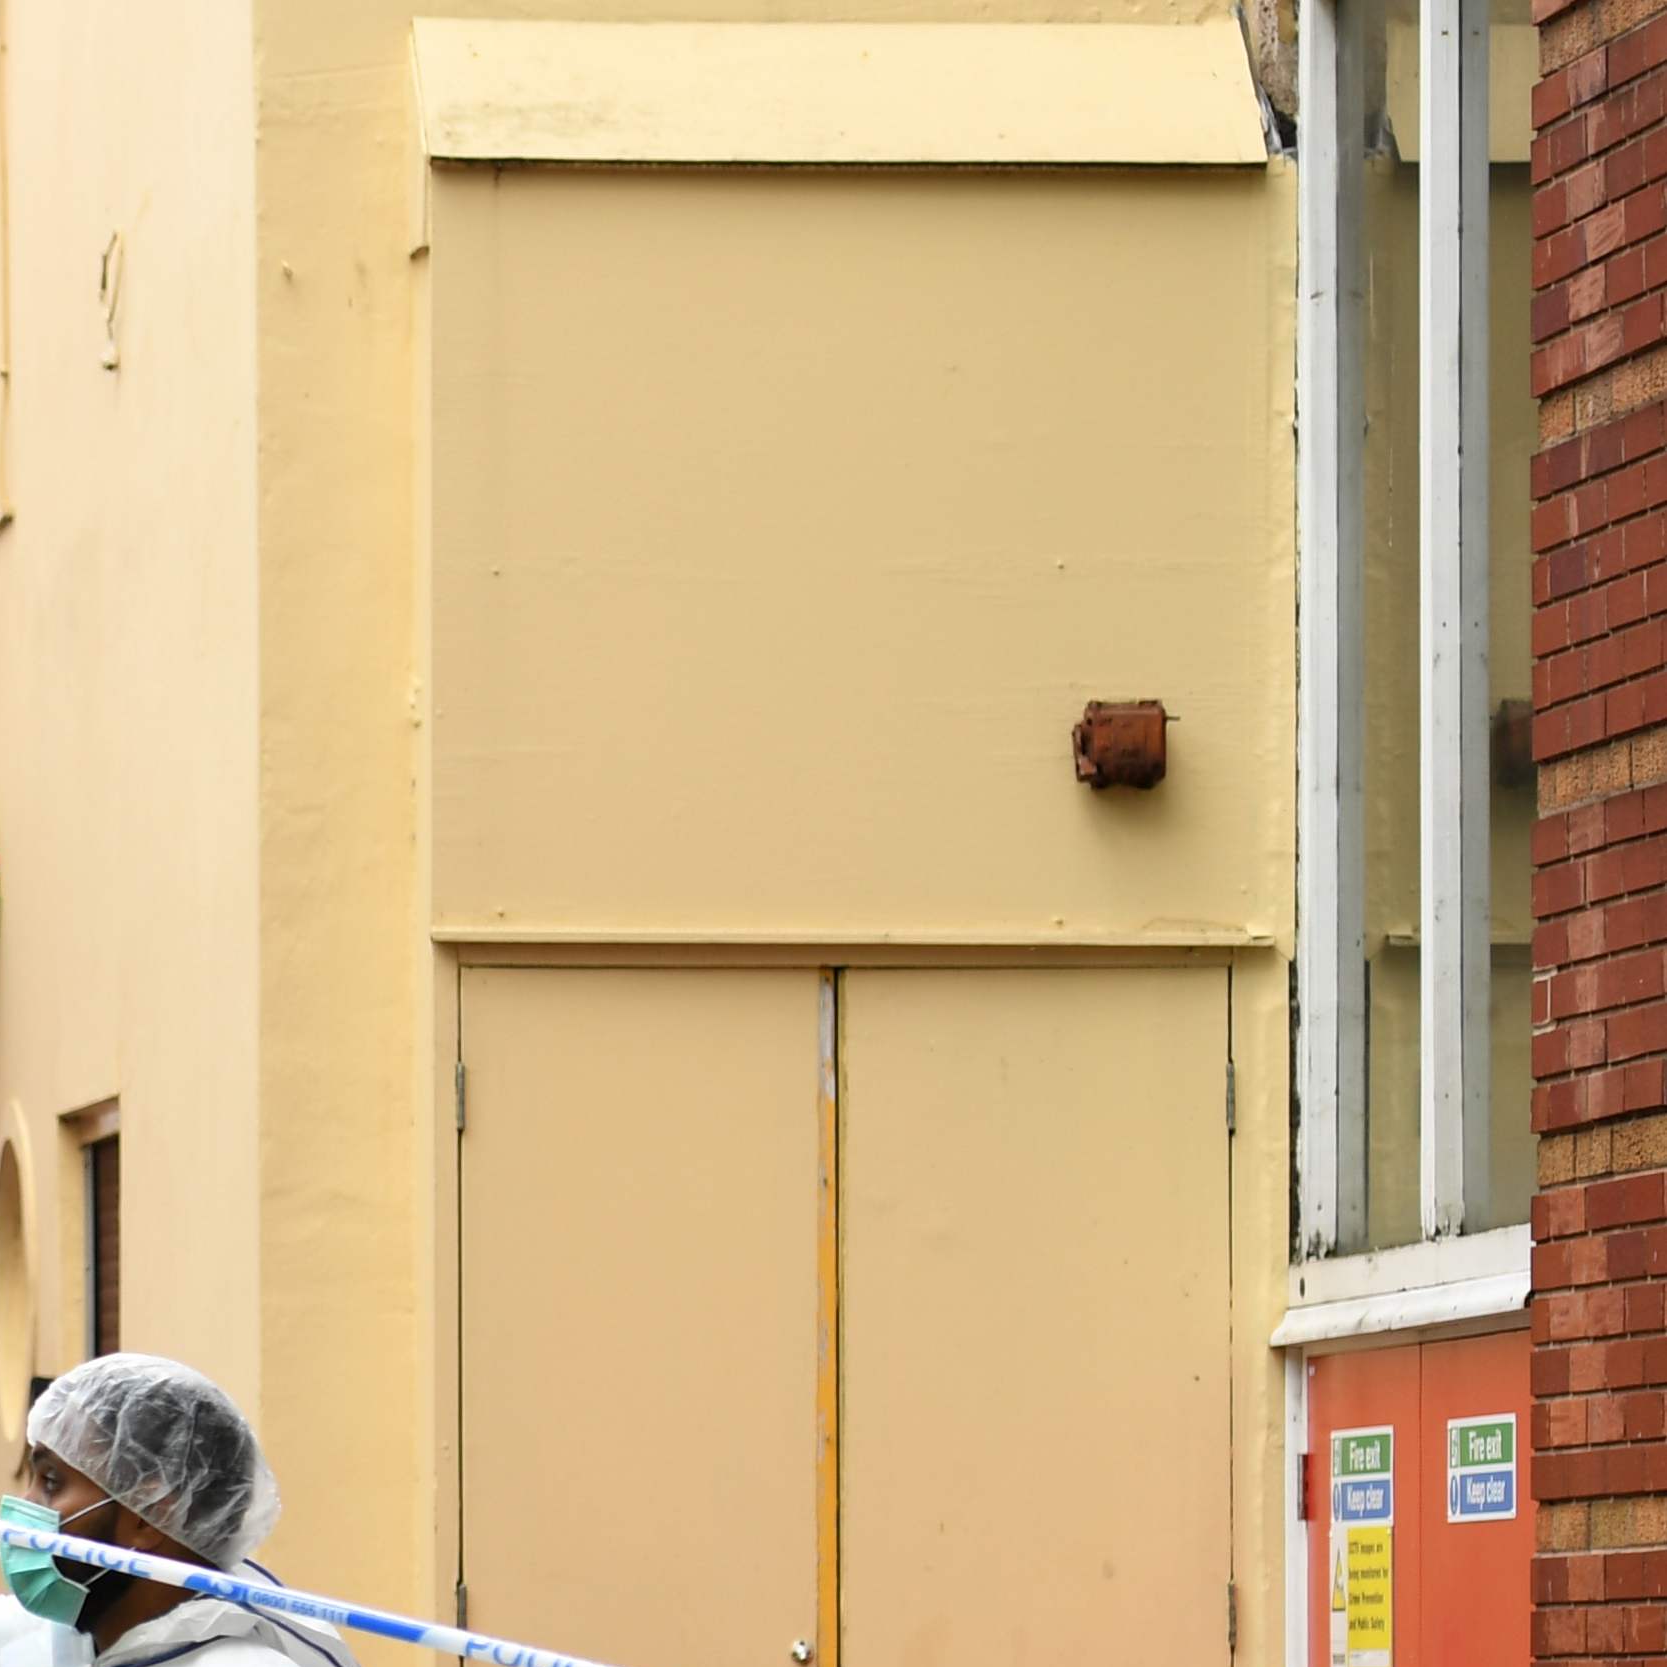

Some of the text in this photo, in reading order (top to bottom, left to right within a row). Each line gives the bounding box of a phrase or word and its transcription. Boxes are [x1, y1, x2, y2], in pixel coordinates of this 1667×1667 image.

[1350, 1440, 1380, 1471] Fire exit
[1468, 1428, 1502, 1462] Fire exit
[1347, 1483, 1384, 1517] Keep clear
[1466, 1475, 1506, 1511] Keep clear
[252, 1592, 287, 1610] 0800
[322, 1609, 344, 1623] 111
